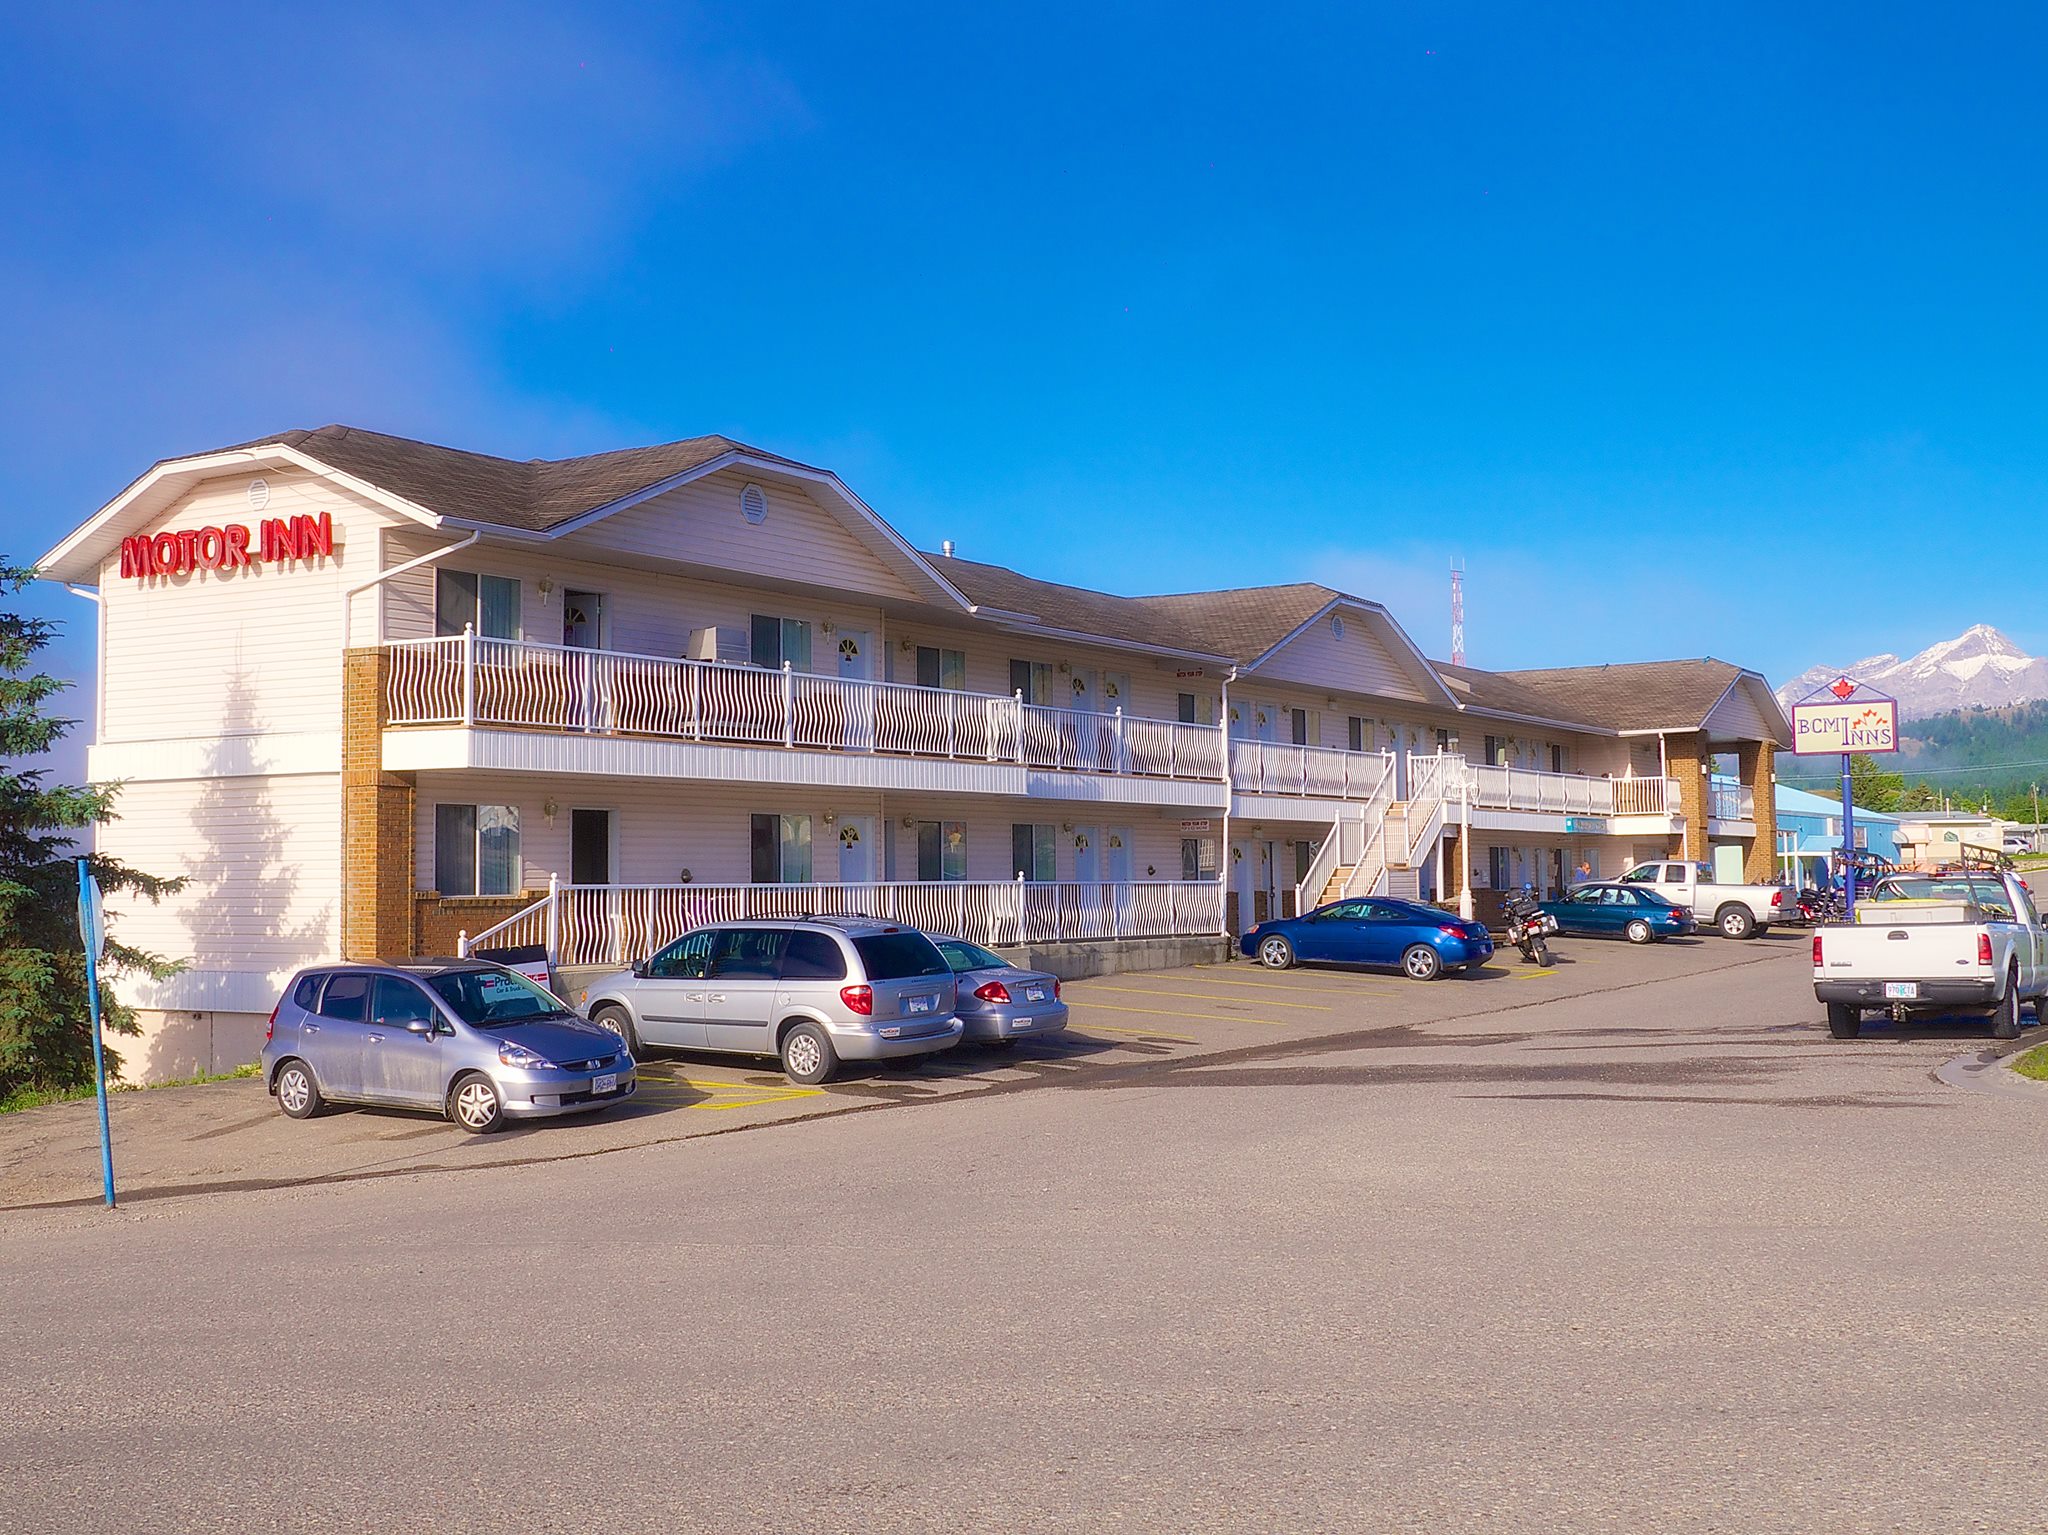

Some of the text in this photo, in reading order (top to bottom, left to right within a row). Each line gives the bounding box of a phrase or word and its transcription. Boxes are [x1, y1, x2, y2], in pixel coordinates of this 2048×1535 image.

[120, 511, 333, 579] MOTOR INN
[1797, 717, 1840, 734] BCM
